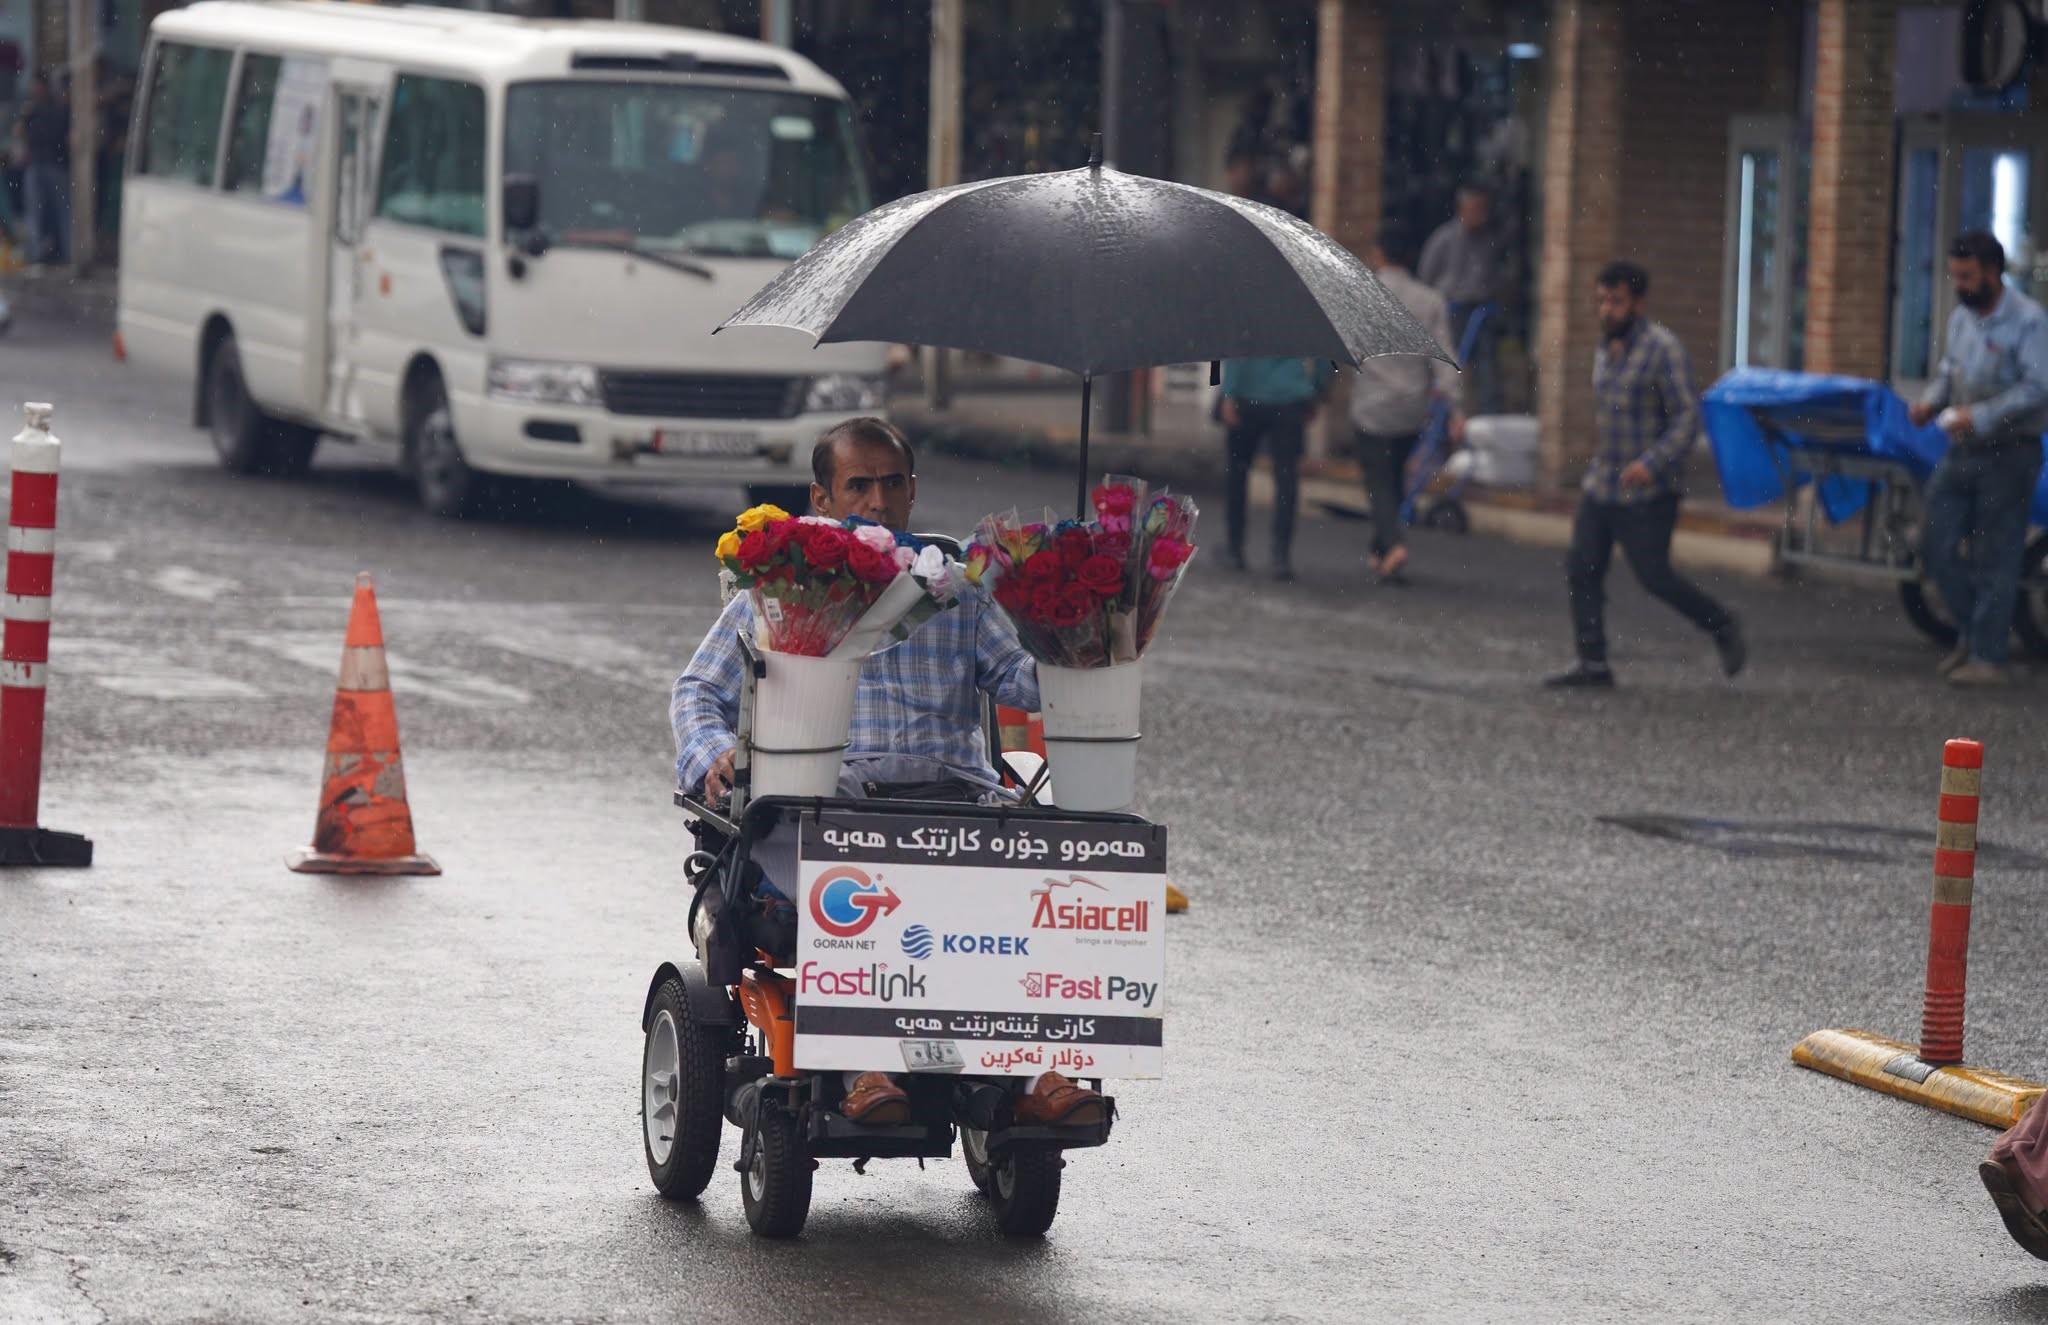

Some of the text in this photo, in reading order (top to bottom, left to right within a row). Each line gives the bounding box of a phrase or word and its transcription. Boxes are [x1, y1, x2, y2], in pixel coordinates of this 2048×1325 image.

[990, 831, 1049, 860] جۆرە
[1031, 890, 1149, 932] Asiacell
[813, 938, 877, 950] GORAN NET
[943, 934, 1030, 956] KOREK
